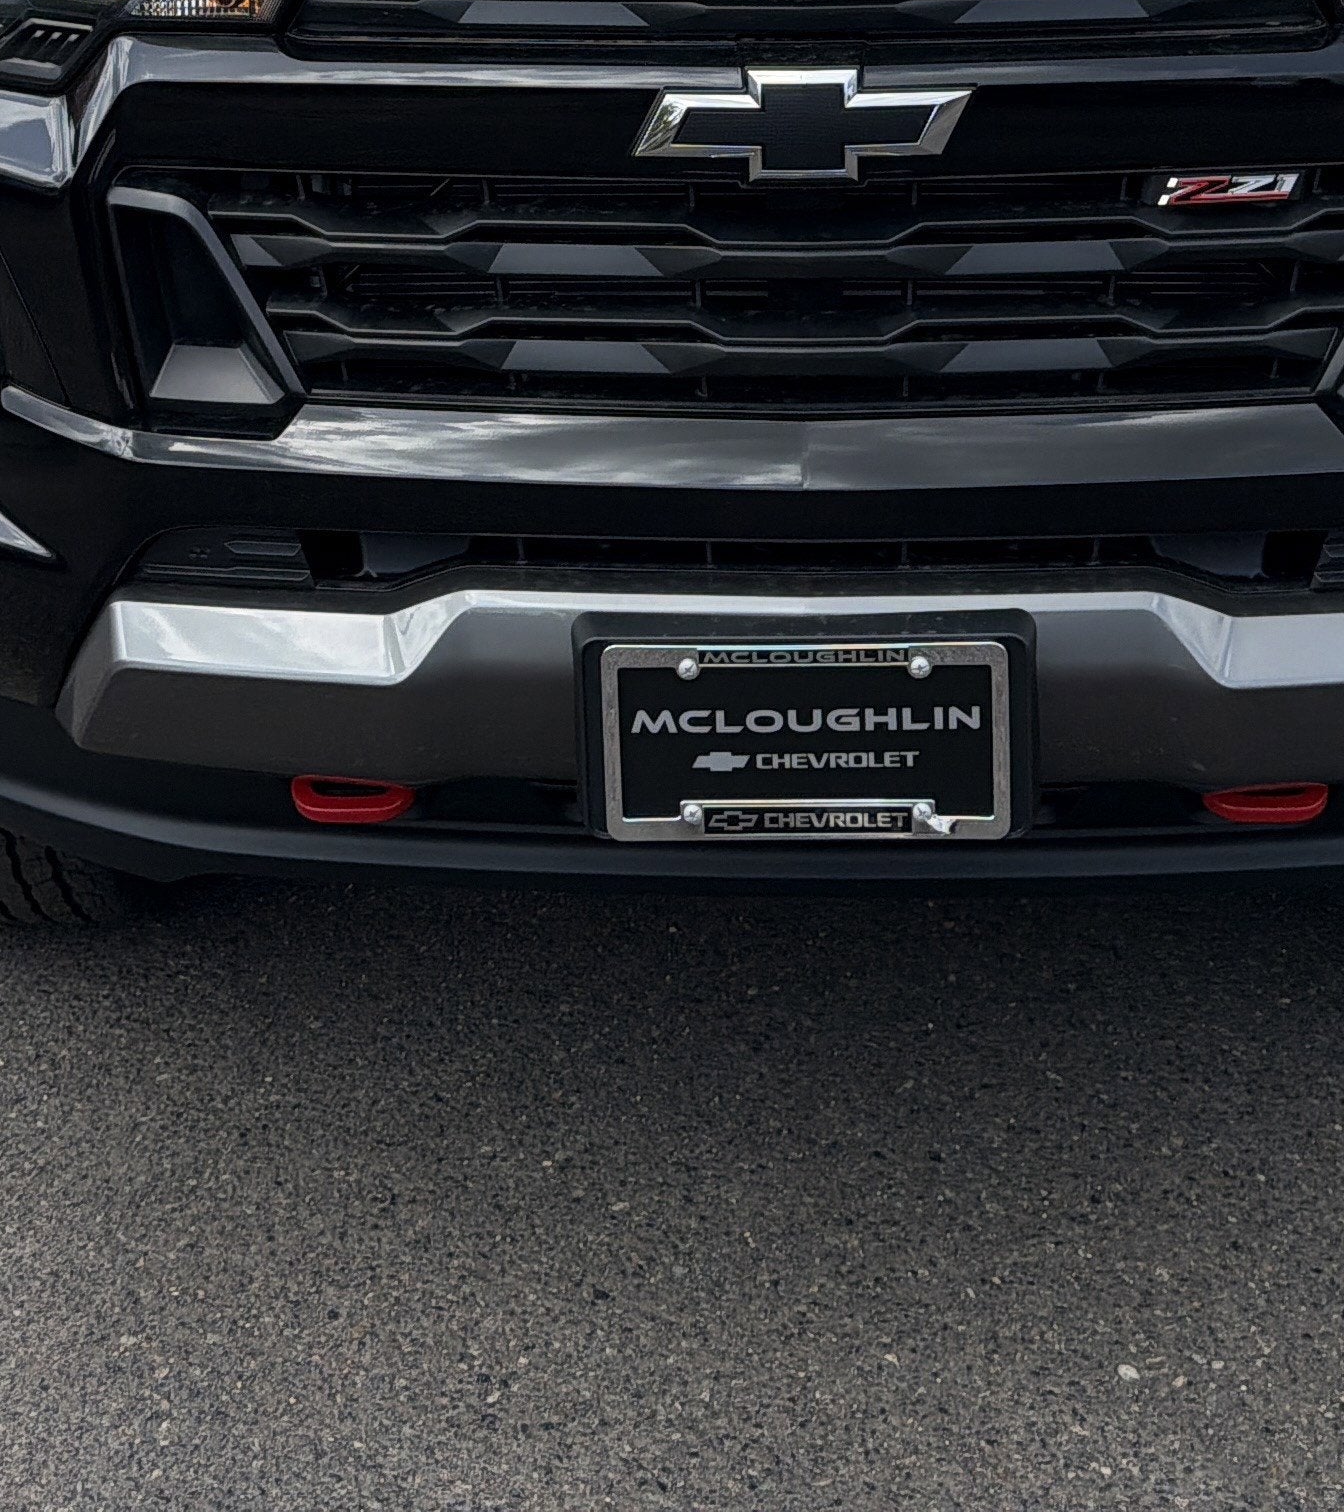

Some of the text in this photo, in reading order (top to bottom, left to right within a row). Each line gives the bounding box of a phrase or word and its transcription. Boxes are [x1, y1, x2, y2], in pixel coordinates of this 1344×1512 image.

[1157, 173, 1300, 206] Z71
[703, 649, 907, 664] MCLOUGHLIN
[630, 705, 981, 734] MCLOUGHLIN
[755, 750, 920, 769] CHEVROLET
[763, 812, 908, 829] CHEVROLET
